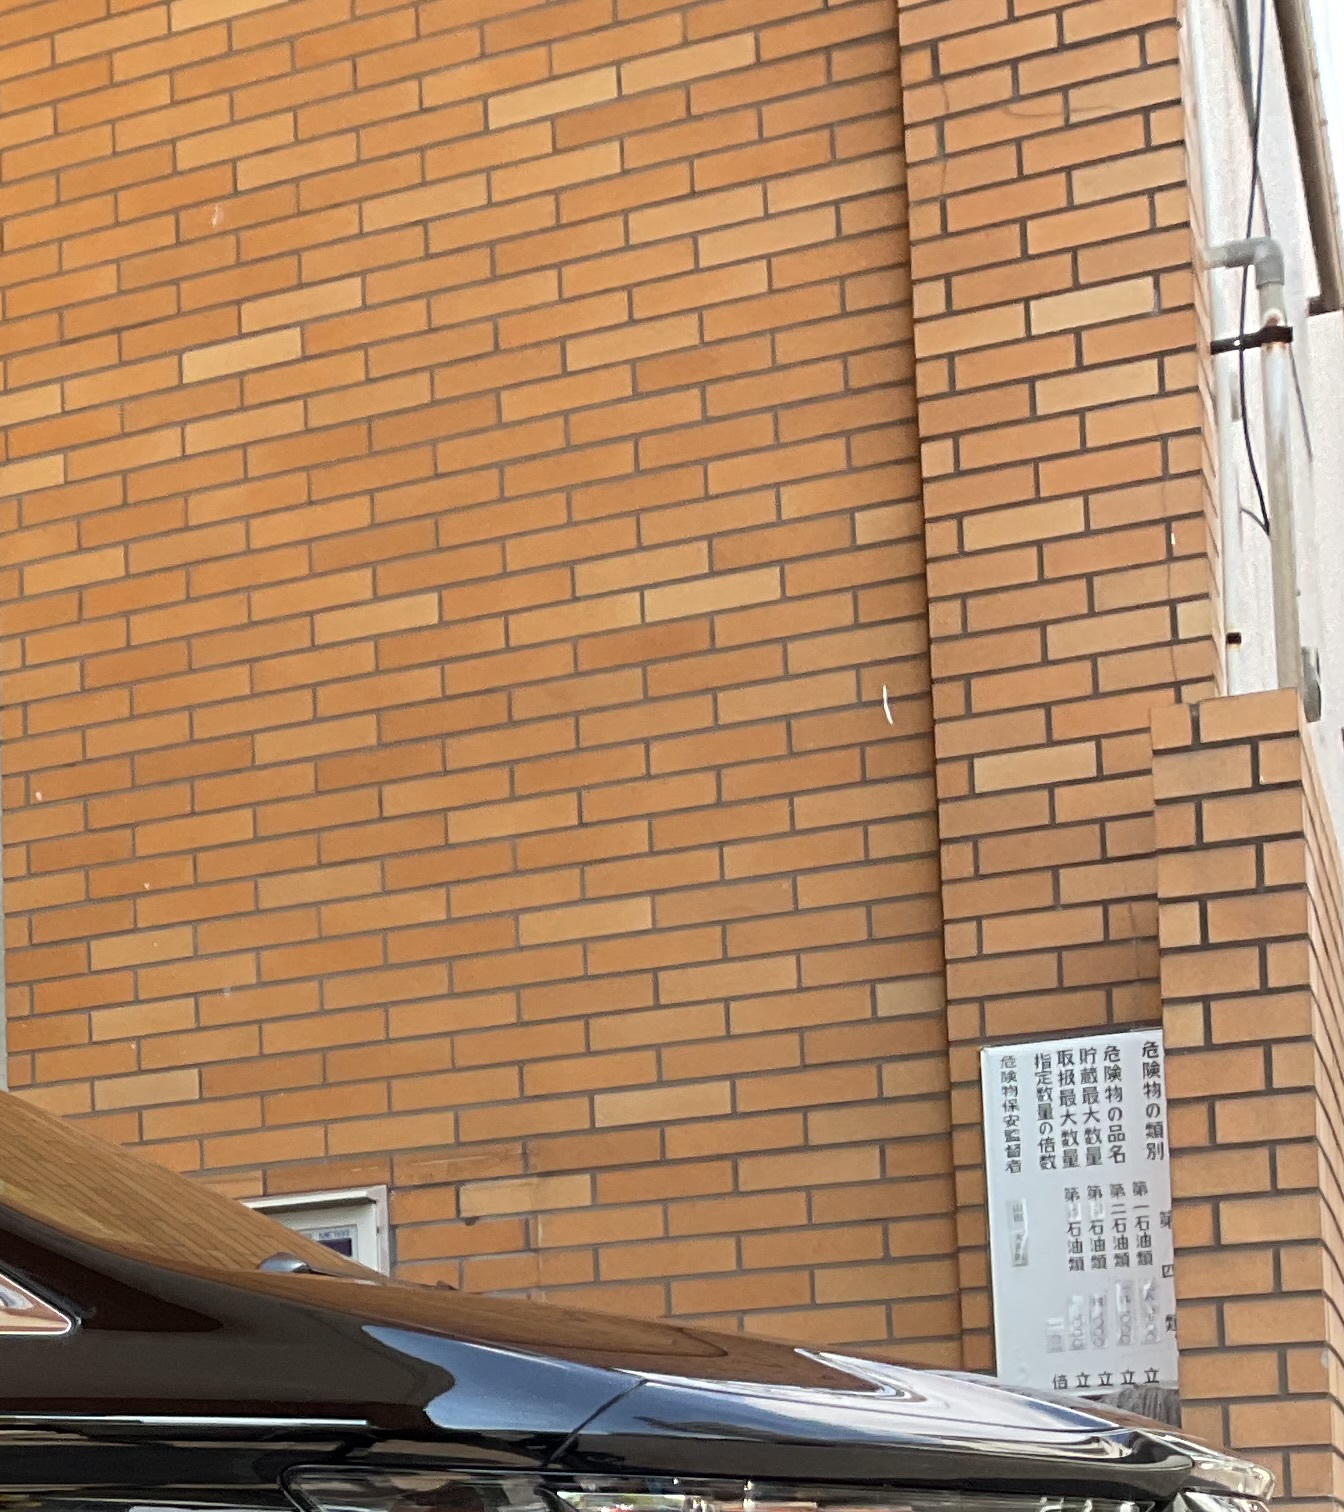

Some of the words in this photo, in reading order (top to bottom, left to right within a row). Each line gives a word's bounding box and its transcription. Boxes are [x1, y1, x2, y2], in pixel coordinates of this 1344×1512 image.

[999, 1054, 1023, 1174] 危険物保安監督者
[1033, 1052, 1058, 1171] 指定数量の倍数
[1057, 1049, 1081, 1170] 取扱最大数量
[1079, 1046, 1104, 1167] 貯蔵最大数量
[1103, 1045, 1127, 1165] 危険物の品名
[1141, 1040, 1166, 1162] 危険物の類別
[1063, 1187, 1086, 1273] 第石油類
[1086, 1184, 1108, 1271] 第石油類
[1109, 1183, 1131, 1269] 第二石油類
[1131, 1180, 1154, 1267] 第一石油類
